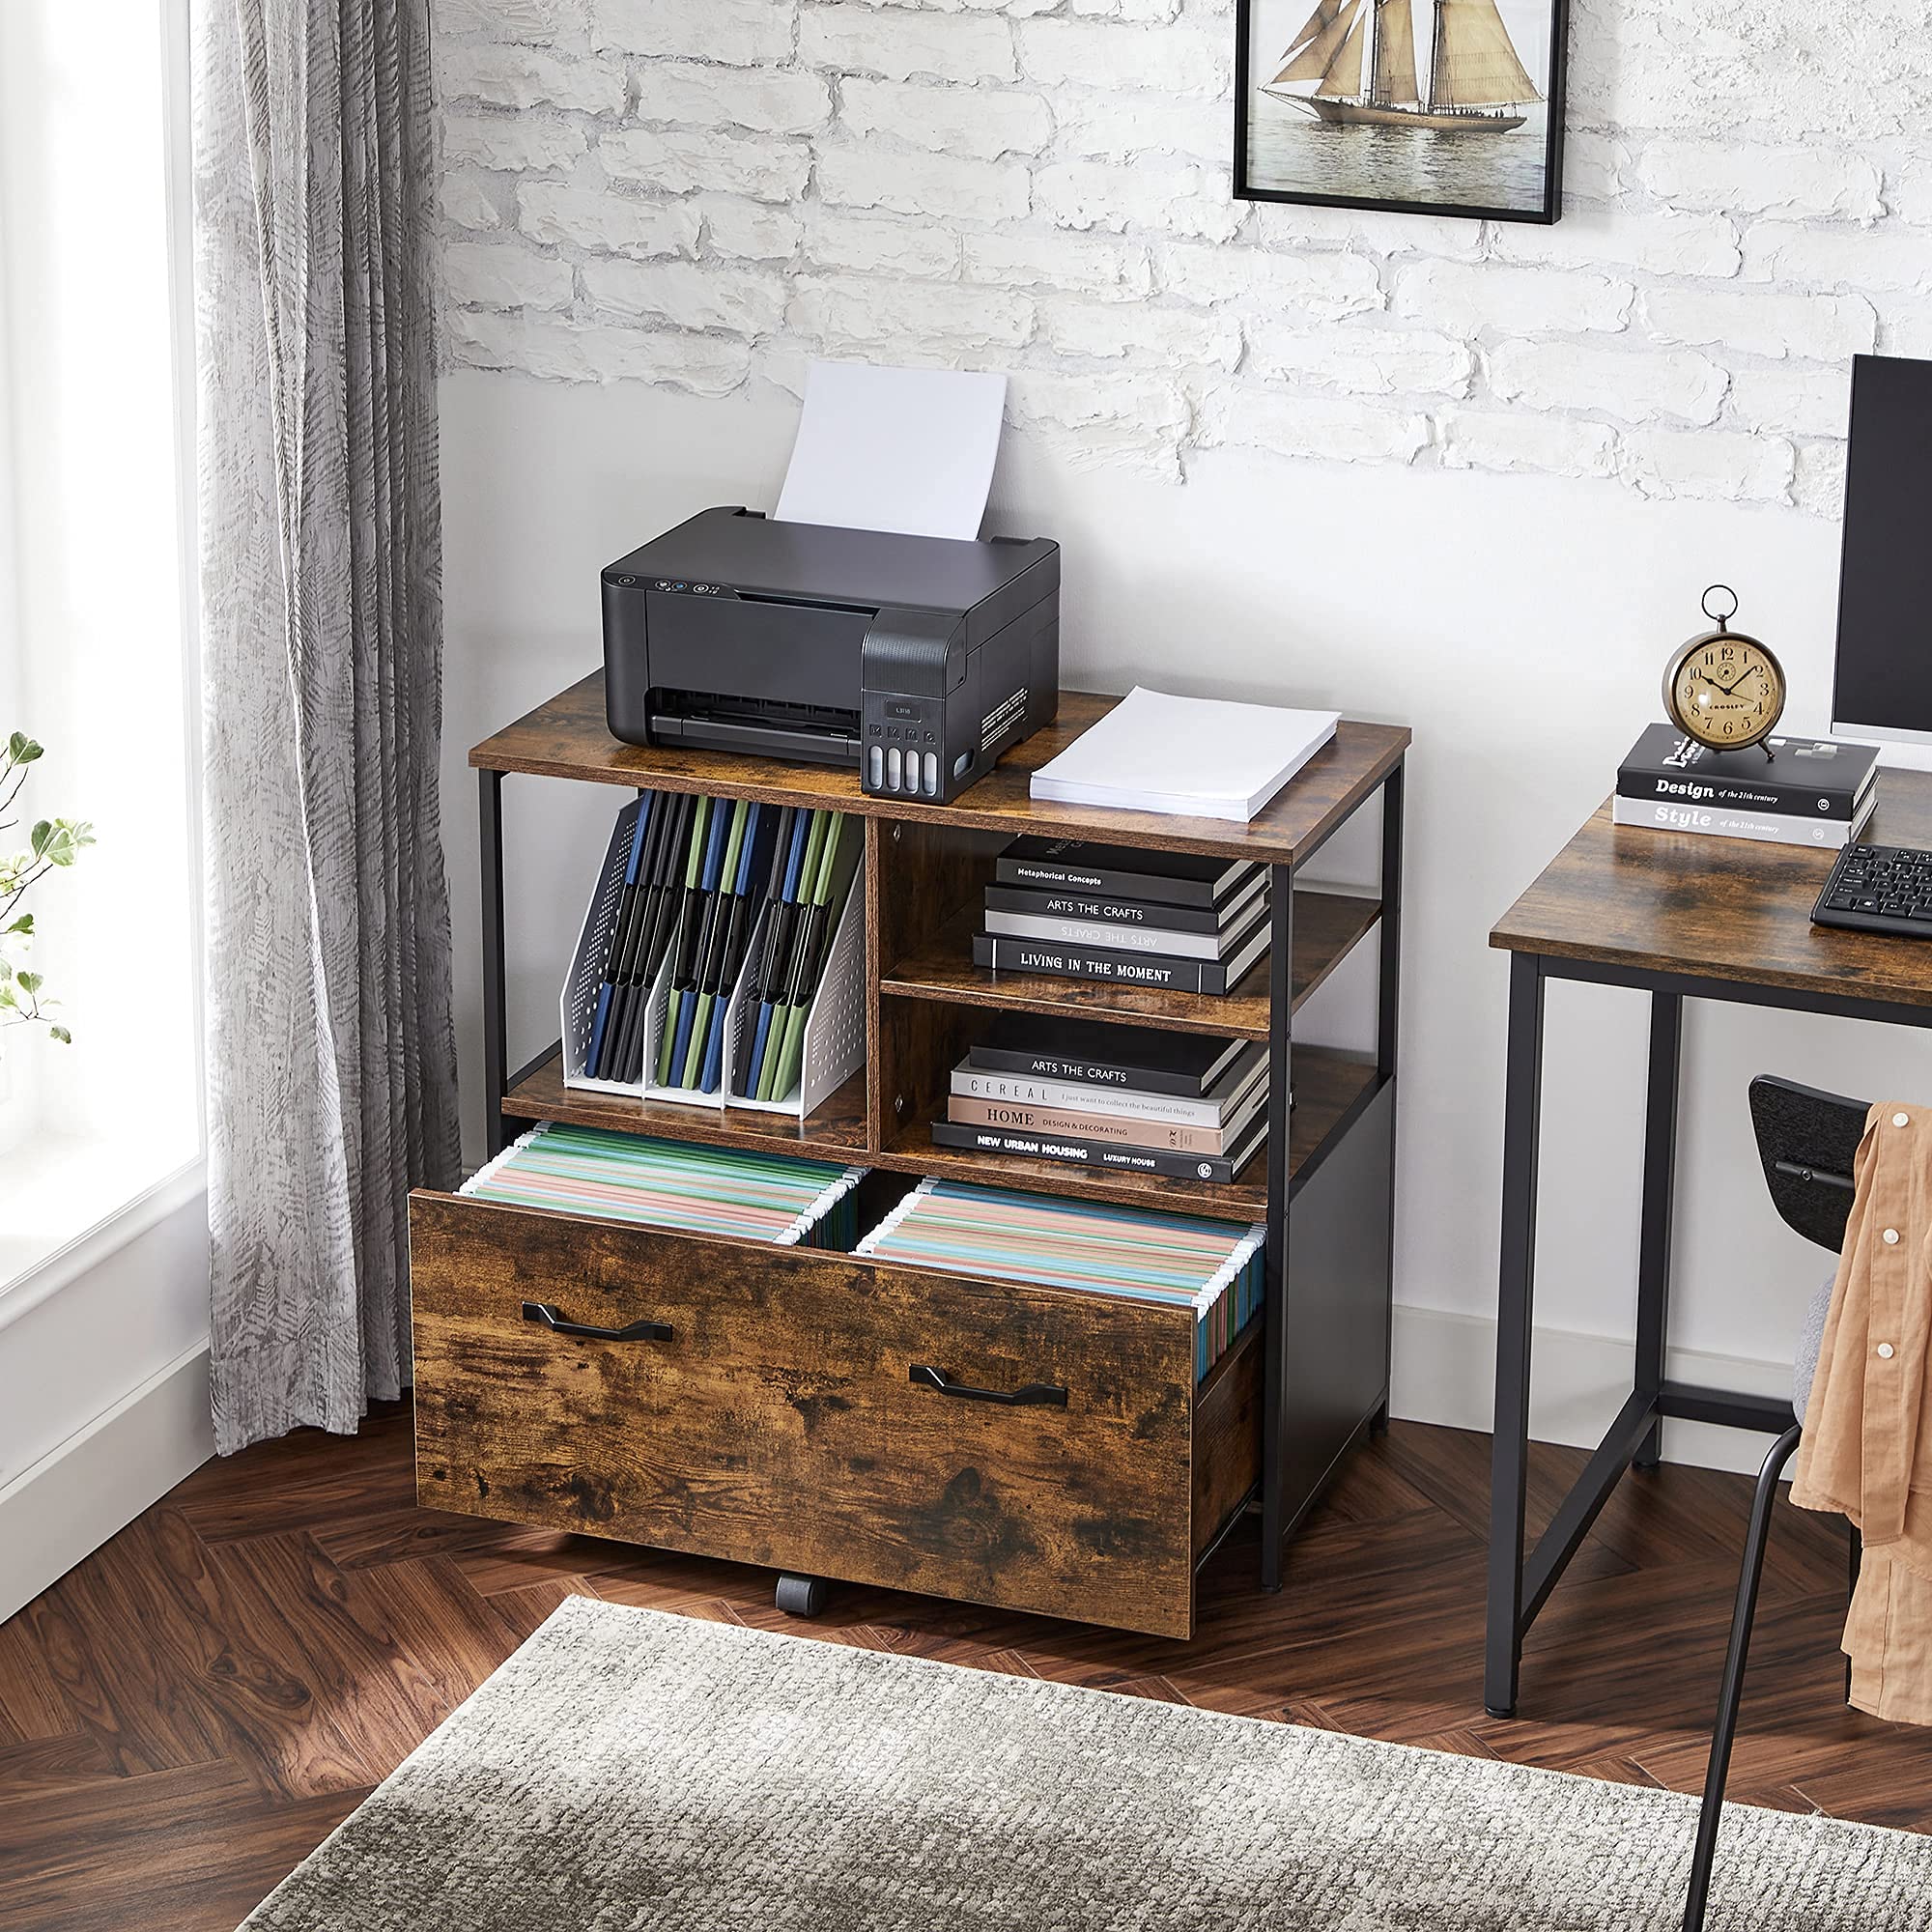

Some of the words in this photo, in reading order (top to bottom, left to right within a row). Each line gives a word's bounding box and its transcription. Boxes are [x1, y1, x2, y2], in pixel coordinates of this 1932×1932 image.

[1705, 652, 1714, 665] 11
[1721, 647, 1734, 661] 12
[1744, 651, 1747, 664] 1
[1690, 667, 1702, 680] 10
[1756, 666, 1764, 677] 2
[1685, 685, 1693, 698] 9
[1760, 683, 1770, 696] 3
[1691, 703, 1700, 717] 8
[1753, 701, 1763, 715] 4
[1704, 717, 1713, 729] 7
[1723, 722, 1733, 735] 6
[1742, 717, 1751, 730] 5
[1655, 779, 1715, 800] Design
[1727, 790, 1738, 799] the
[1753, 794, 1778, 804] century
[1655, 807, 1712, 828] Style
[1728, 820, 1739, 829] the
[1754, 824, 1779, 835] century
[1017, 867, 1065, 882] Metaphorical
[1067, 873, 1102, 887] Concepts
[1047, 899, 1074, 912] ARTS
[1078, 902, 1099, 915] THE
[1103, 906, 1144, 920] CRAFTS
[1061, 926, 1100, 940] CRAFTS
[1105, 931, 1126, 943] THE
[1130, 934, 1157, 947] ARTS
[1020, 952, 1063, 969] LIVING
[1067, 958, 1082, 971] IN
[1086, 961, 1111, 975] THE
[1117, 964, 1172, 982] MOMENT
[1031, 1060, 1058, 1073] ARTS
[1063, 1064, 1083, 1076] THE
[1087, 1067, 1126, 1083] CRAFTS
[971, 1079, 1048, 1101] CEREAL
[1106, 1099, 1128, 1108] collect
[1142, 1104, 1173, 1114] beautiful
[1174, 1107, 1195, 1117] things
[987, 1108, 1035, 1126] HOME
[1042, 1119, 1071, 1129] DESIGN
[1079, 1122, 1128, 1136] DECORATING
[977, 1135, 1001, 1148] NEW
[1004, 1138, 1038, 1152] URBAN
[1041, 1143, 1089, 1159] HOUSING
[1103, 1153, 1131, 1165] LUXURY
[1131, 1157, 1156, 1168] HOUSE
